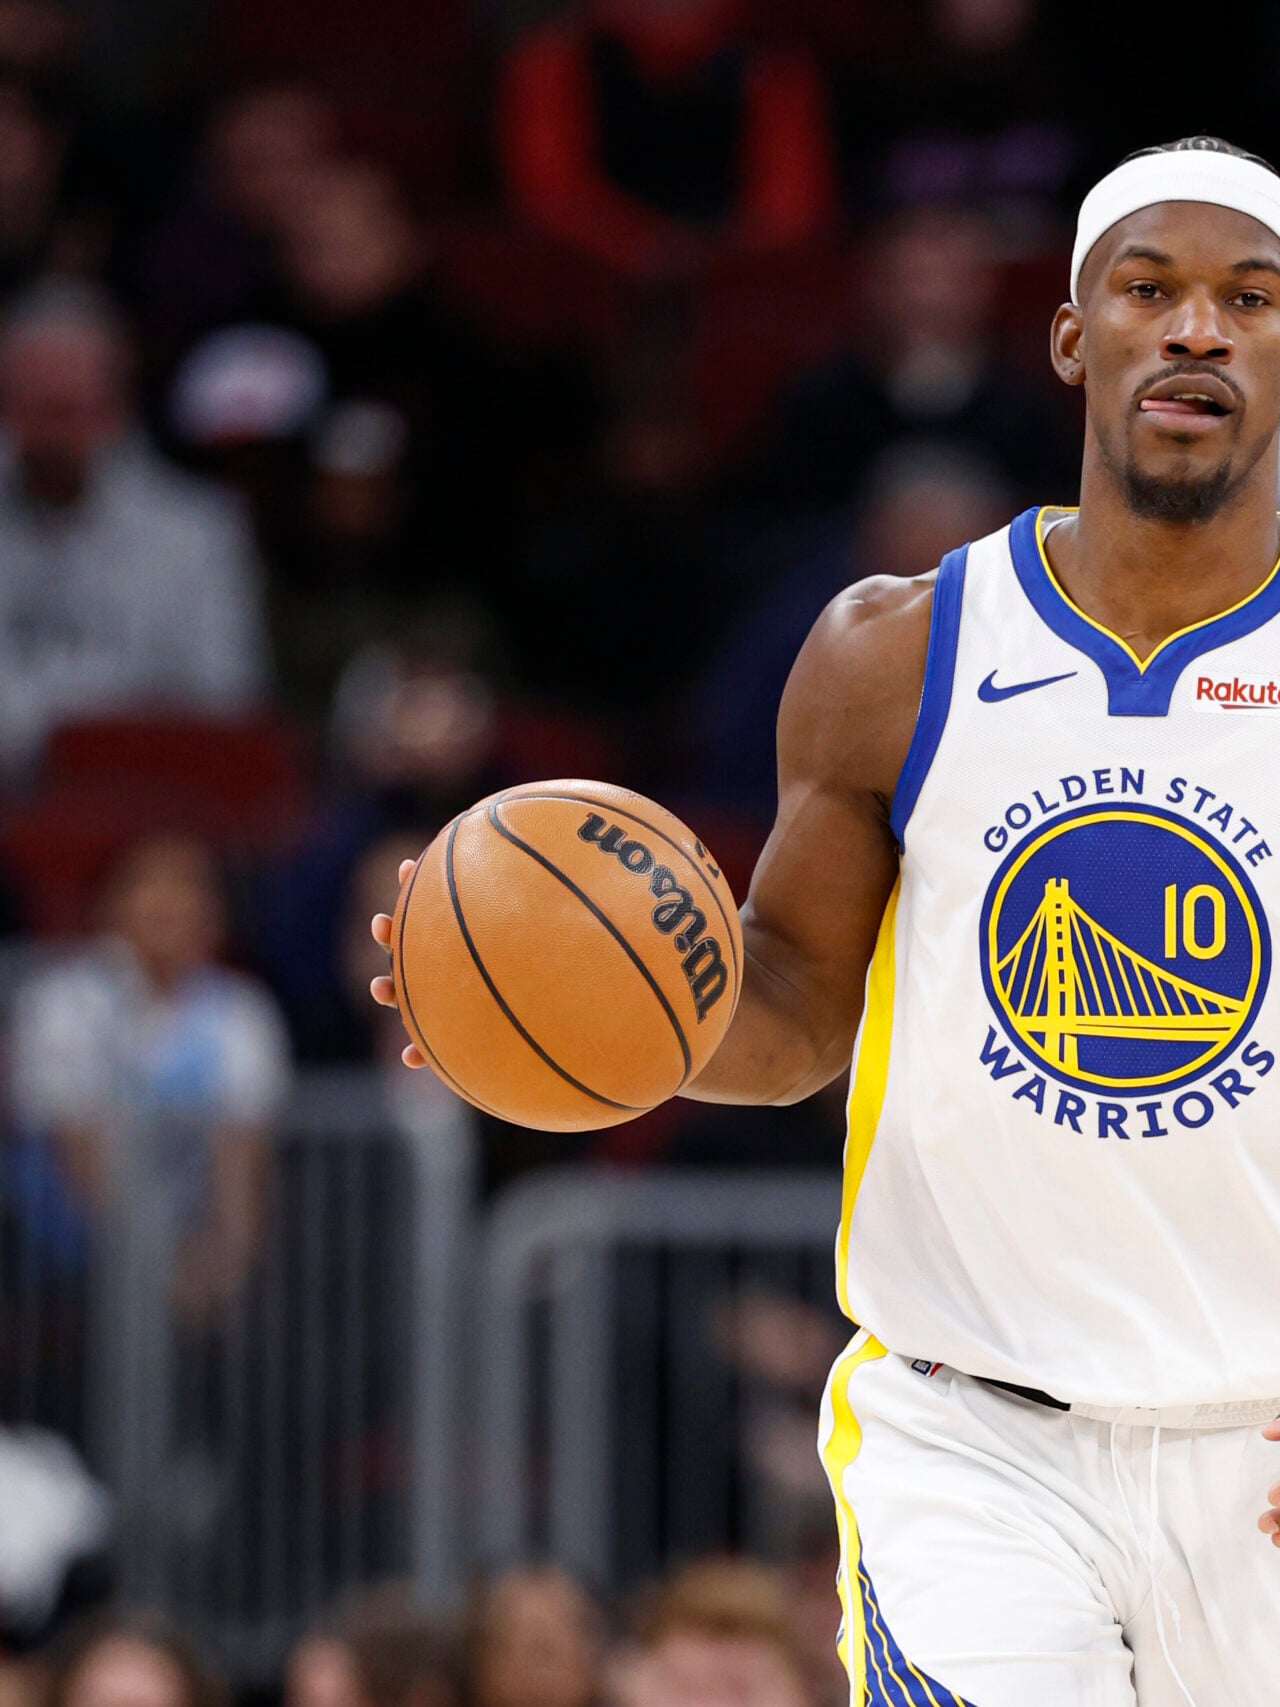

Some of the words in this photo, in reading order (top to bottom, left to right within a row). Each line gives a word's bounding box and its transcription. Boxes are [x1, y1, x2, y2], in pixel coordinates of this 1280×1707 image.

[983, 767, 1145, 853] GOLDEN
[1165, 777, 1273, 868] STATE
[577, 812, 728, 1025] Wilson
[1164, 883, 1226, 960] 10
[979, 1024, 1275, 1140] WARRIORS
